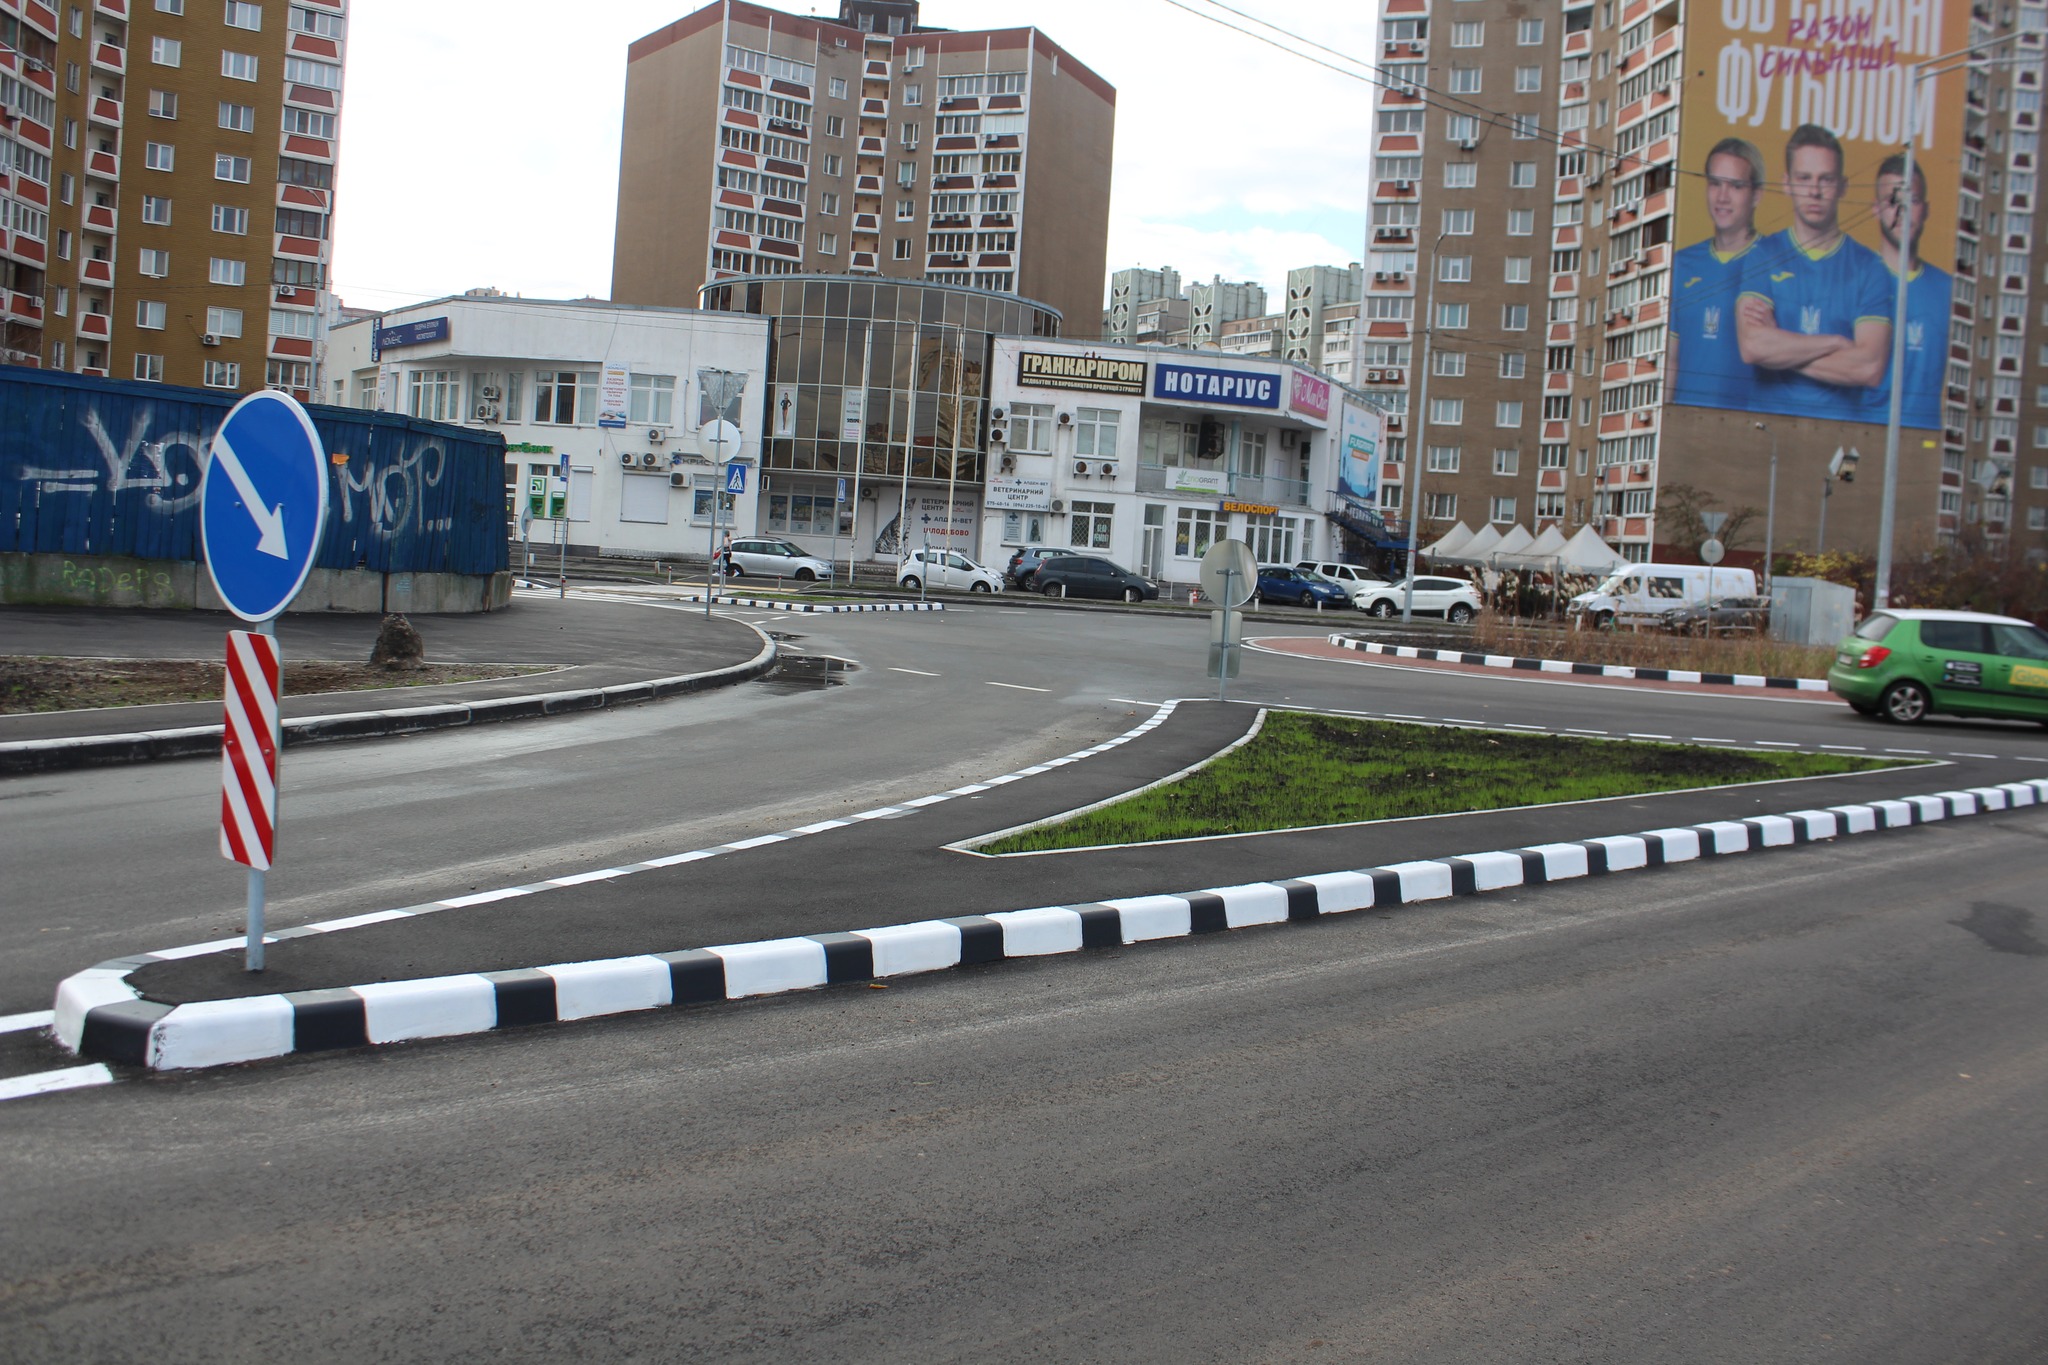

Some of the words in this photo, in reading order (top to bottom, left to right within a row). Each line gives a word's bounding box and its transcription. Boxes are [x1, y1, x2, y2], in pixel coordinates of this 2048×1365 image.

[1023, 353, 1143, 381] ГРАНКАРПРОМ
[1165, 371, 1271, 401] НОТАРІУС
[993, 486, 1044, 495] ВЕТЕРИНАРНИЙ
[921, 498, 974, 507] ВЕТЕРИАРНИЙ
[1223, 502, 1280, 515] ВЕЛОСПОРТ
